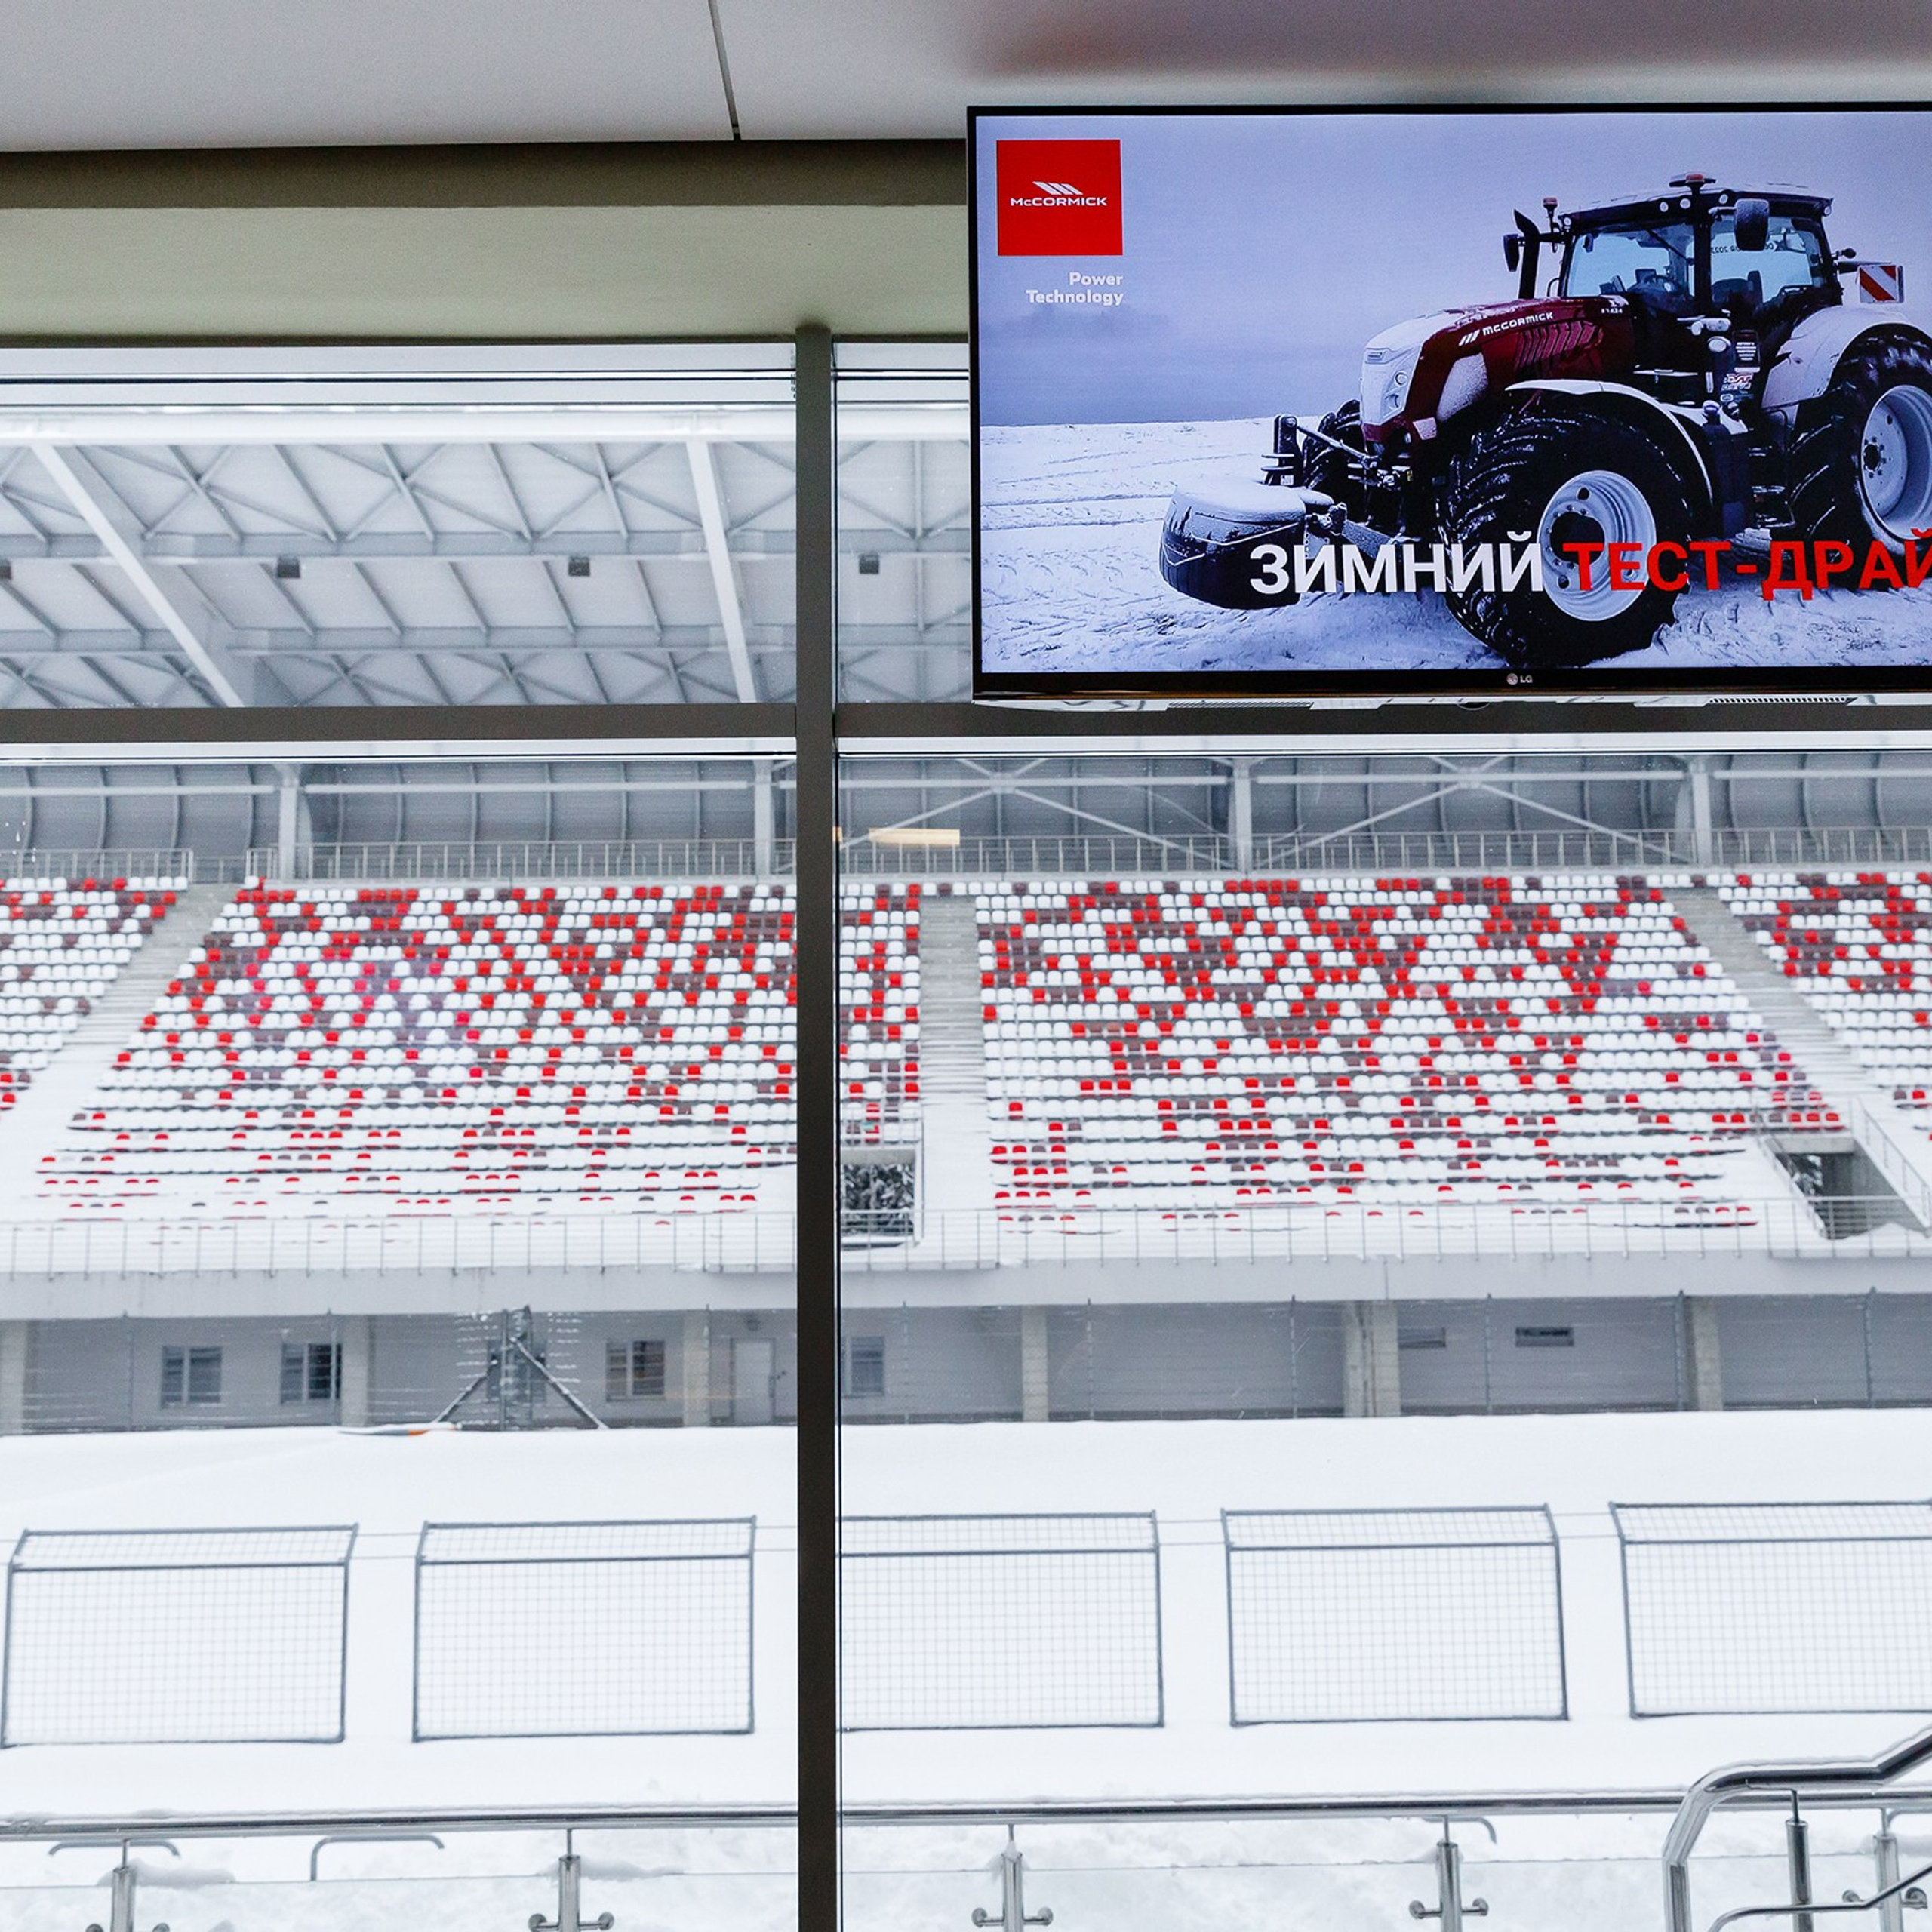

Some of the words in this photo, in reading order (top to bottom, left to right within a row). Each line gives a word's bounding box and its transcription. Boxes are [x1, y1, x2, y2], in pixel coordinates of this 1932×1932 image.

[1010, 197, 1108, 207] McCORMICK
[1069, 271, 1124, 285] Power
[1025, 288, 1124, 306] Technology
[1249, 530, 1544, 595] ЗИМНИЙ
